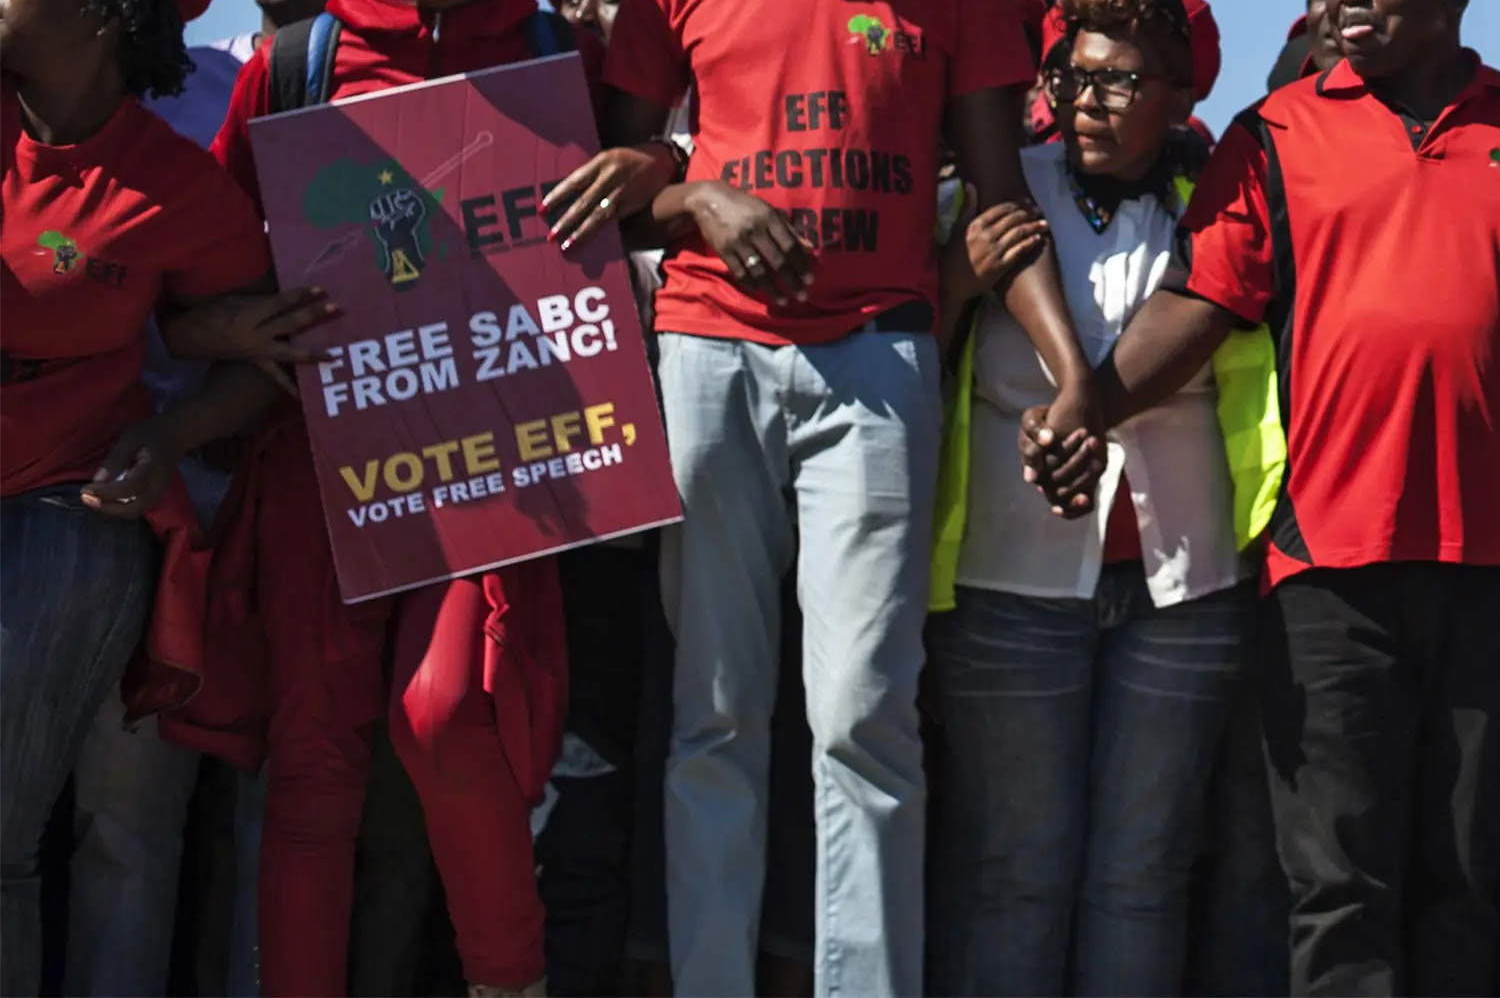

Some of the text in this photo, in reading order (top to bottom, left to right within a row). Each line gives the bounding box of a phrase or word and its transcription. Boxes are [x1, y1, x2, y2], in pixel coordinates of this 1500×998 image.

[786, 89, 849, 132] EFF
[720, 148, 914, 195] ELECTIONS
[776, 207, 879, 253] REW
[318, 286, 609, 384] FREE SABC
[323, 319, 618, 418] FROM ZANC!
[339, 402, 637, 503] VOTE EFF,
[347, 442, 623, 528] VOTE FREE SPEECH
